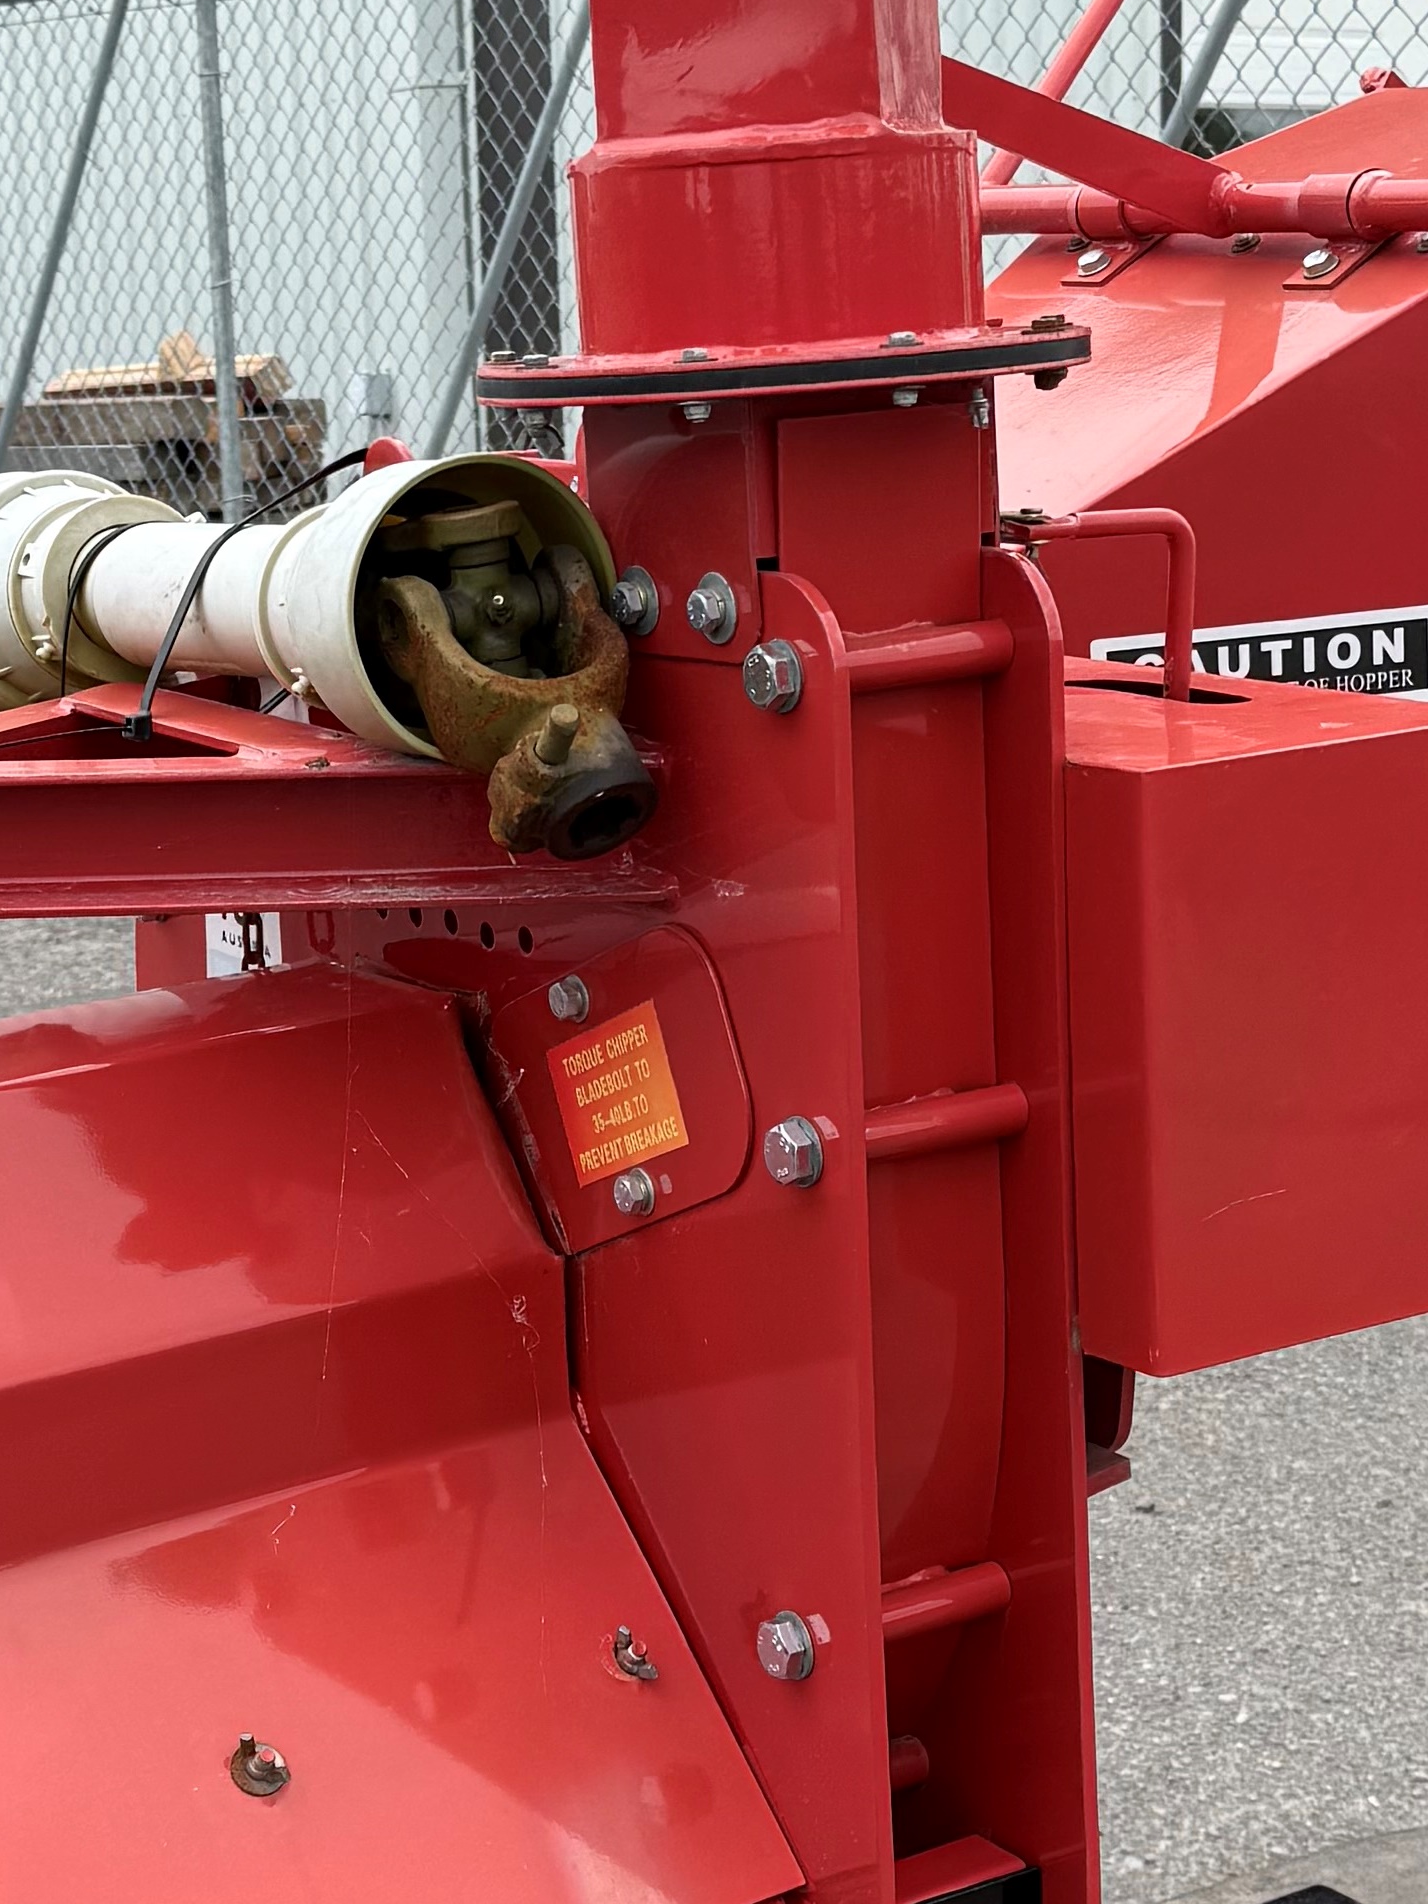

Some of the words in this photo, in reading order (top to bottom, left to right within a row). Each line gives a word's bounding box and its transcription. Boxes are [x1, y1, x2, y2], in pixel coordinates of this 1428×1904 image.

[1336, 669, 1414, 692] HOPPER
[562, 1044, 604, 1078] TORQUE
[606, 1024, 649, 1059] CHIPPER
[575, 1065, 633, 1108] BLADEBOLT
[634, 1058, 651, 1082] TO
[579, 1137, 625, 1173] PREVENT
[624, 1116, 679, 1154] BREAKAGE
